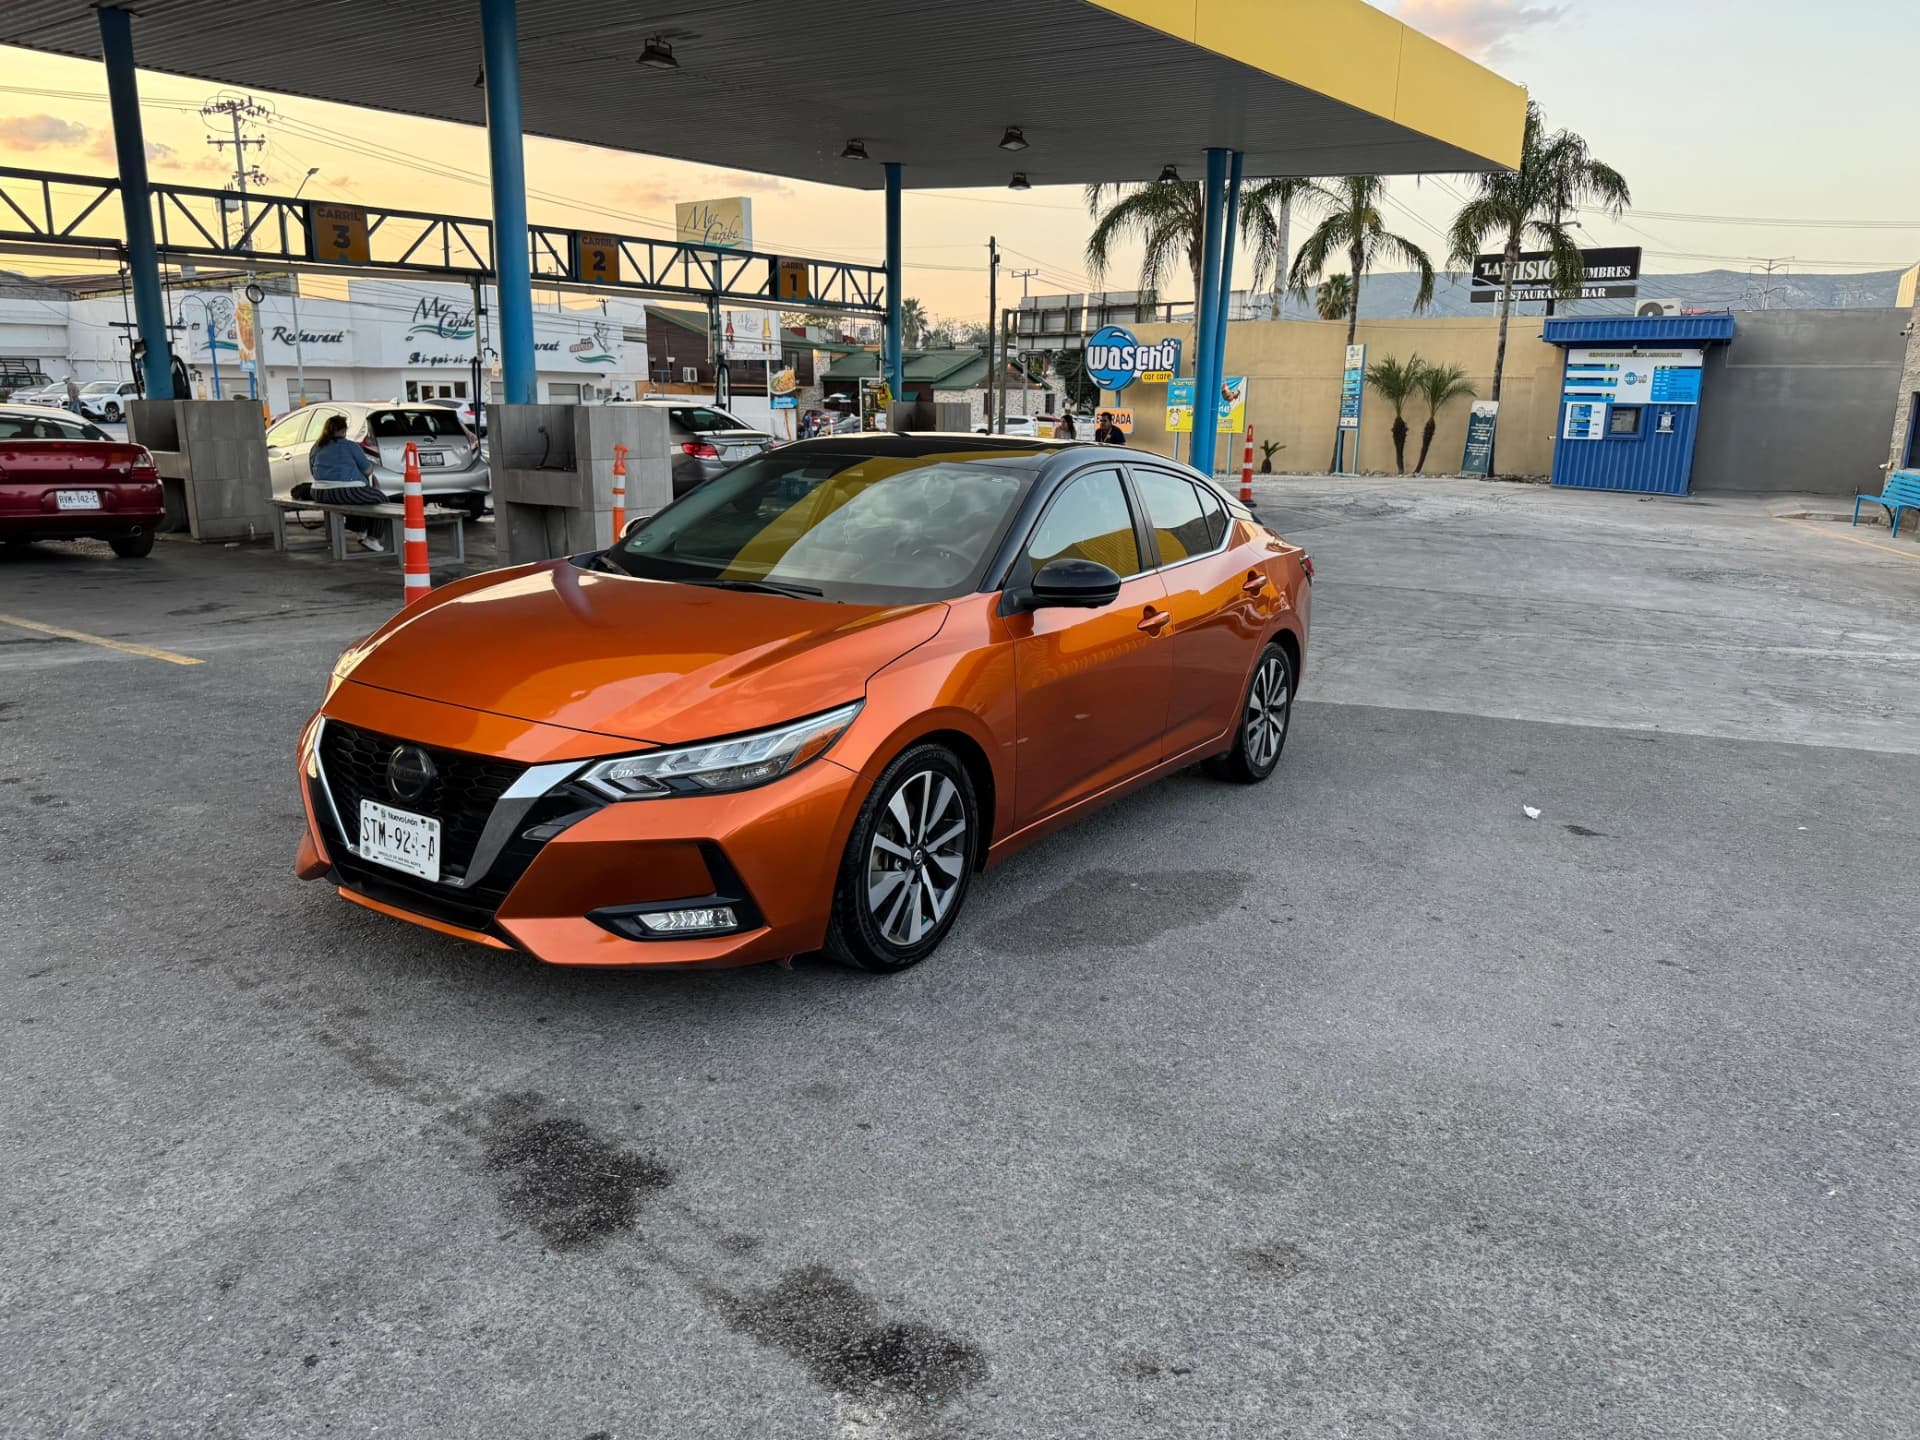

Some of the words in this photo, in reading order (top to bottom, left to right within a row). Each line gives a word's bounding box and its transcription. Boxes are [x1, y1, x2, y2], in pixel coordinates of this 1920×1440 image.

[317, 208, 360, 221] CARRIL
[332, 224, 351, 248] 3
[592, 250, 607, 272] 2
[1481, 262, 1501, 276] LA
[1582, 265, 1631, 279] UMBRES
[790, 273, 798, 292] 1
[1581, 287, 1606, 298] BAR
[413, 296, 452, 323] Mar
[439, 308, 475, 338] Caribe
[271, 326, 345, 346] Restaurant
[1096, 413, 1132, 425] ERADA
